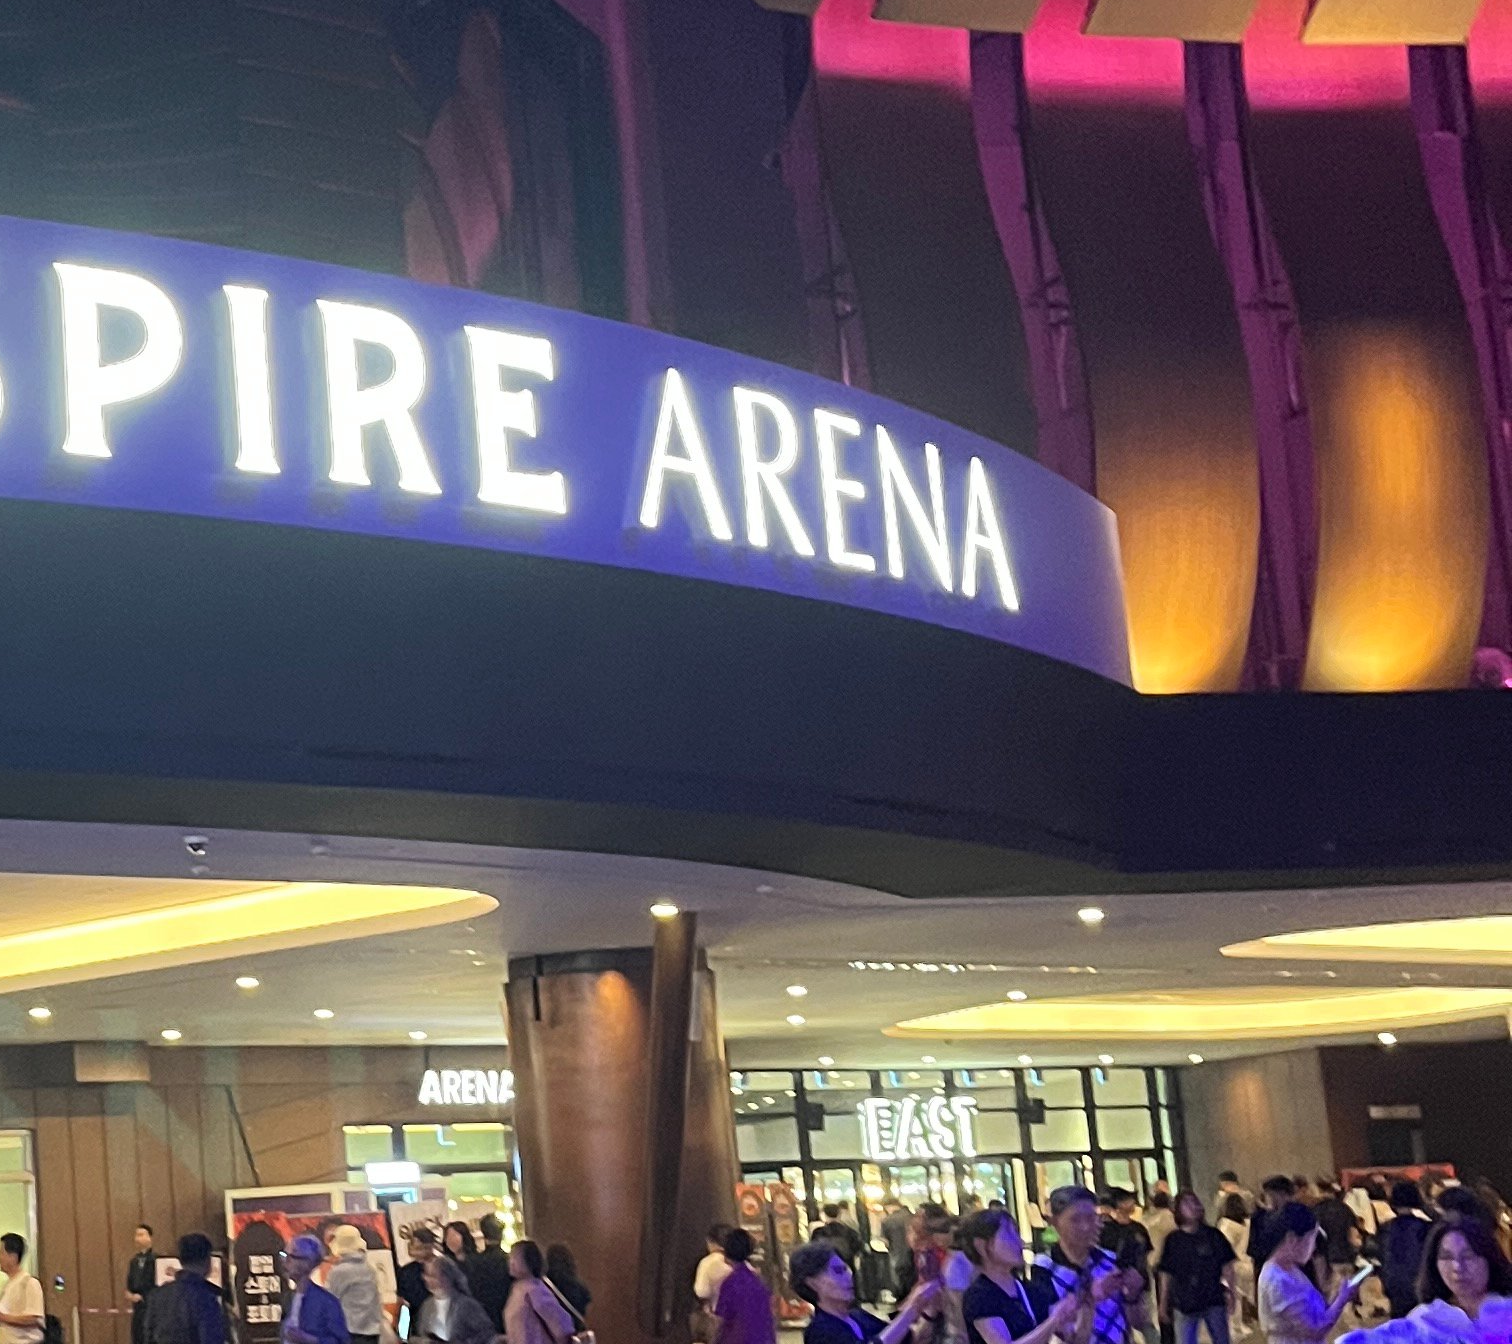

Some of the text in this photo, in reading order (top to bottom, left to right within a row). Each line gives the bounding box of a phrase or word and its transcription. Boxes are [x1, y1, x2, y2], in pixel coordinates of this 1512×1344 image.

[638, 366, 1020, 611] ARENA
[418, 1069, 516, 1105] ARENA
[858, 1096, 978, 1159] EAST
